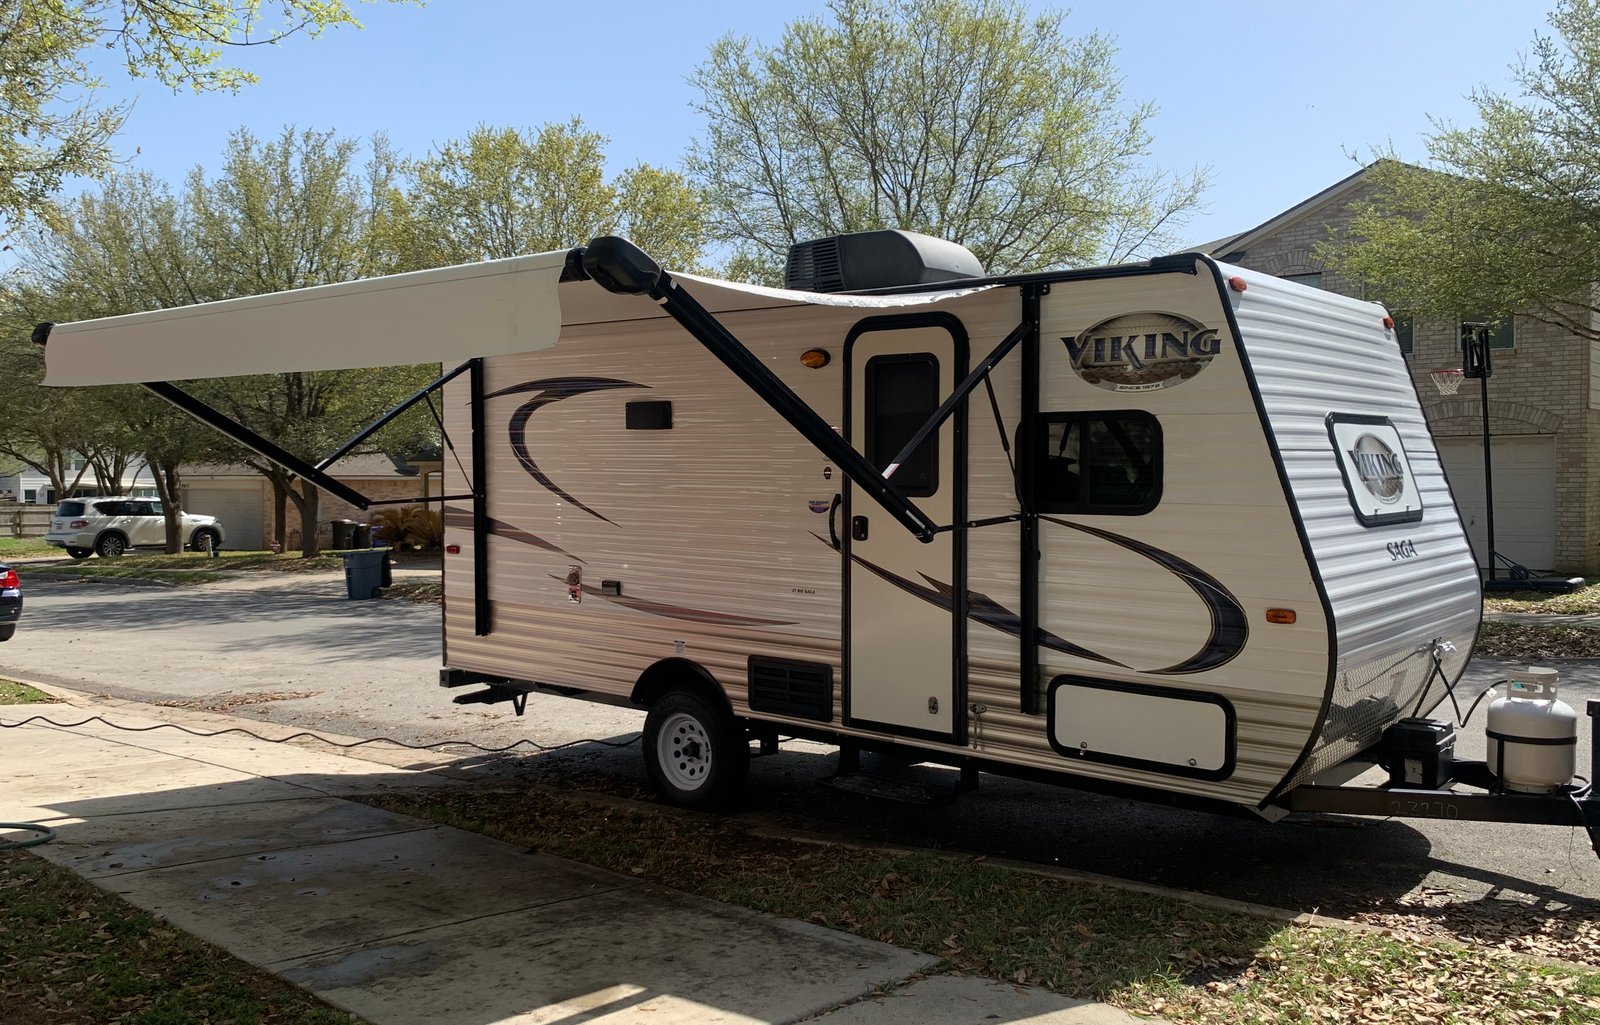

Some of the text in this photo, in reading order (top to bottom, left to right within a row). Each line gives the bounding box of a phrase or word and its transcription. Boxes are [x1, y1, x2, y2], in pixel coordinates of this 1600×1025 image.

[1059, 328, 1222, 371] VIKING
[1346, 450, 1404, 483] VIKING
[1386, 539, 1419, 562] SAGA
